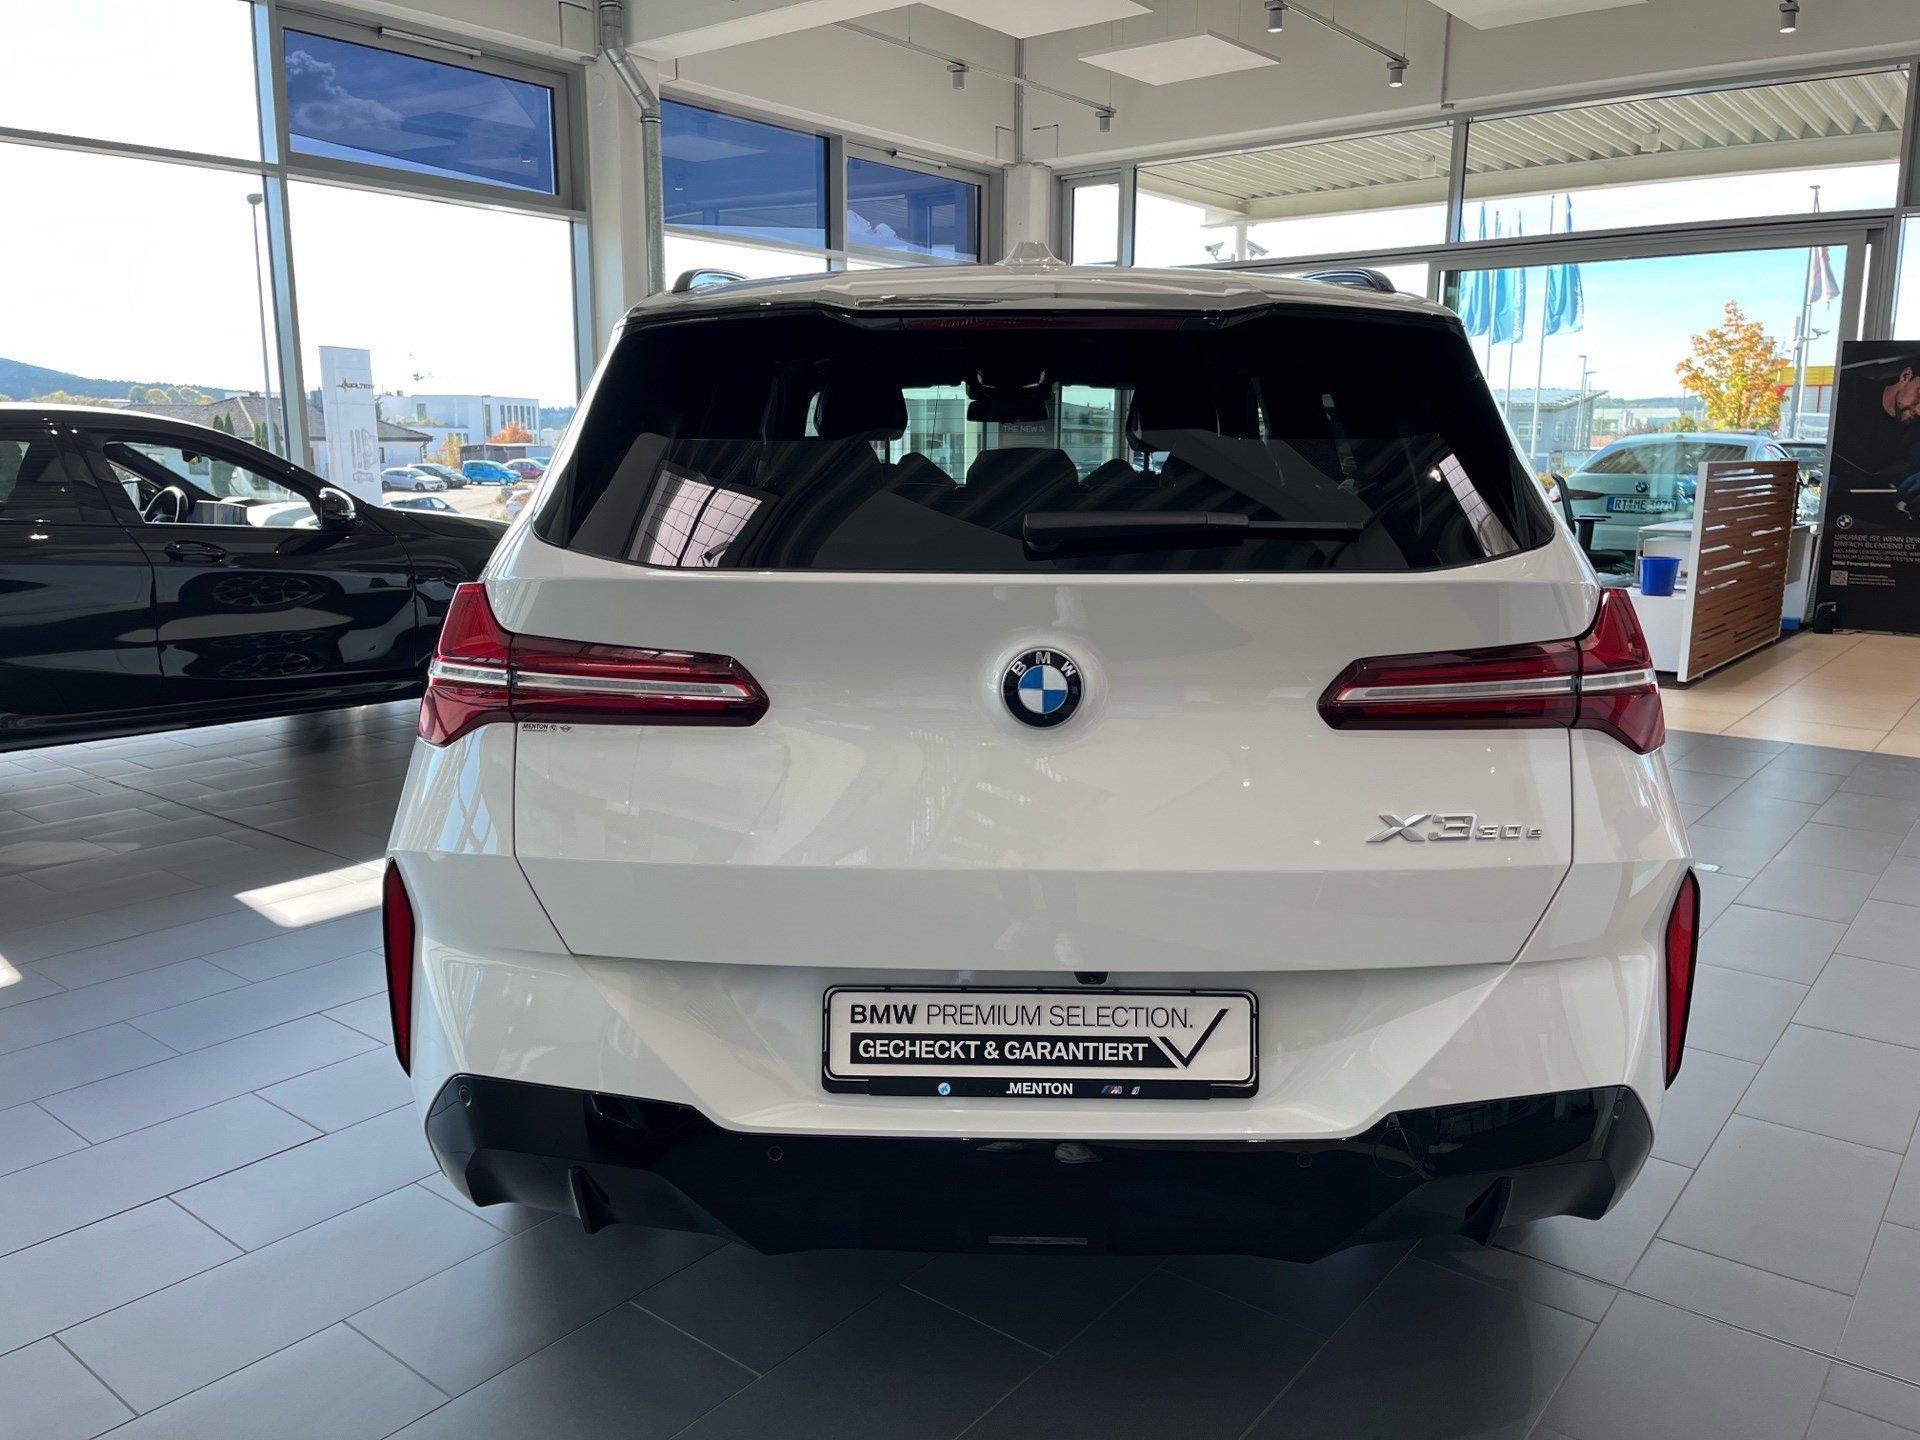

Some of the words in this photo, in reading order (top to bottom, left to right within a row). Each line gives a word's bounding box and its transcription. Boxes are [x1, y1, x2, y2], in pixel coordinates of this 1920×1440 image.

[1020, 425, 1037, 433] NEW
[1834, 534, 1868, 542] UPGRADE
[1882, 535, 1904, 543] WENN
[1864, 541, 1904, 550] BLENDEND
[1011, 651, 1077, 677] BMW
[1366, 813, 1478, 843] X3
[850, 1004, 918, 1024] BMW
[927, 1004, 1042, 1026] PREMIUM
[1049, 1005, 1194, 1029] SELECTION.
[858, 1039, 980, 1059] GECHECKT
[983, 1041, 1000, 1059] &
[1004, 1041, 1149, 1061] GARANTIERT
[1006, 1082, 1073, 1095] MENTON
